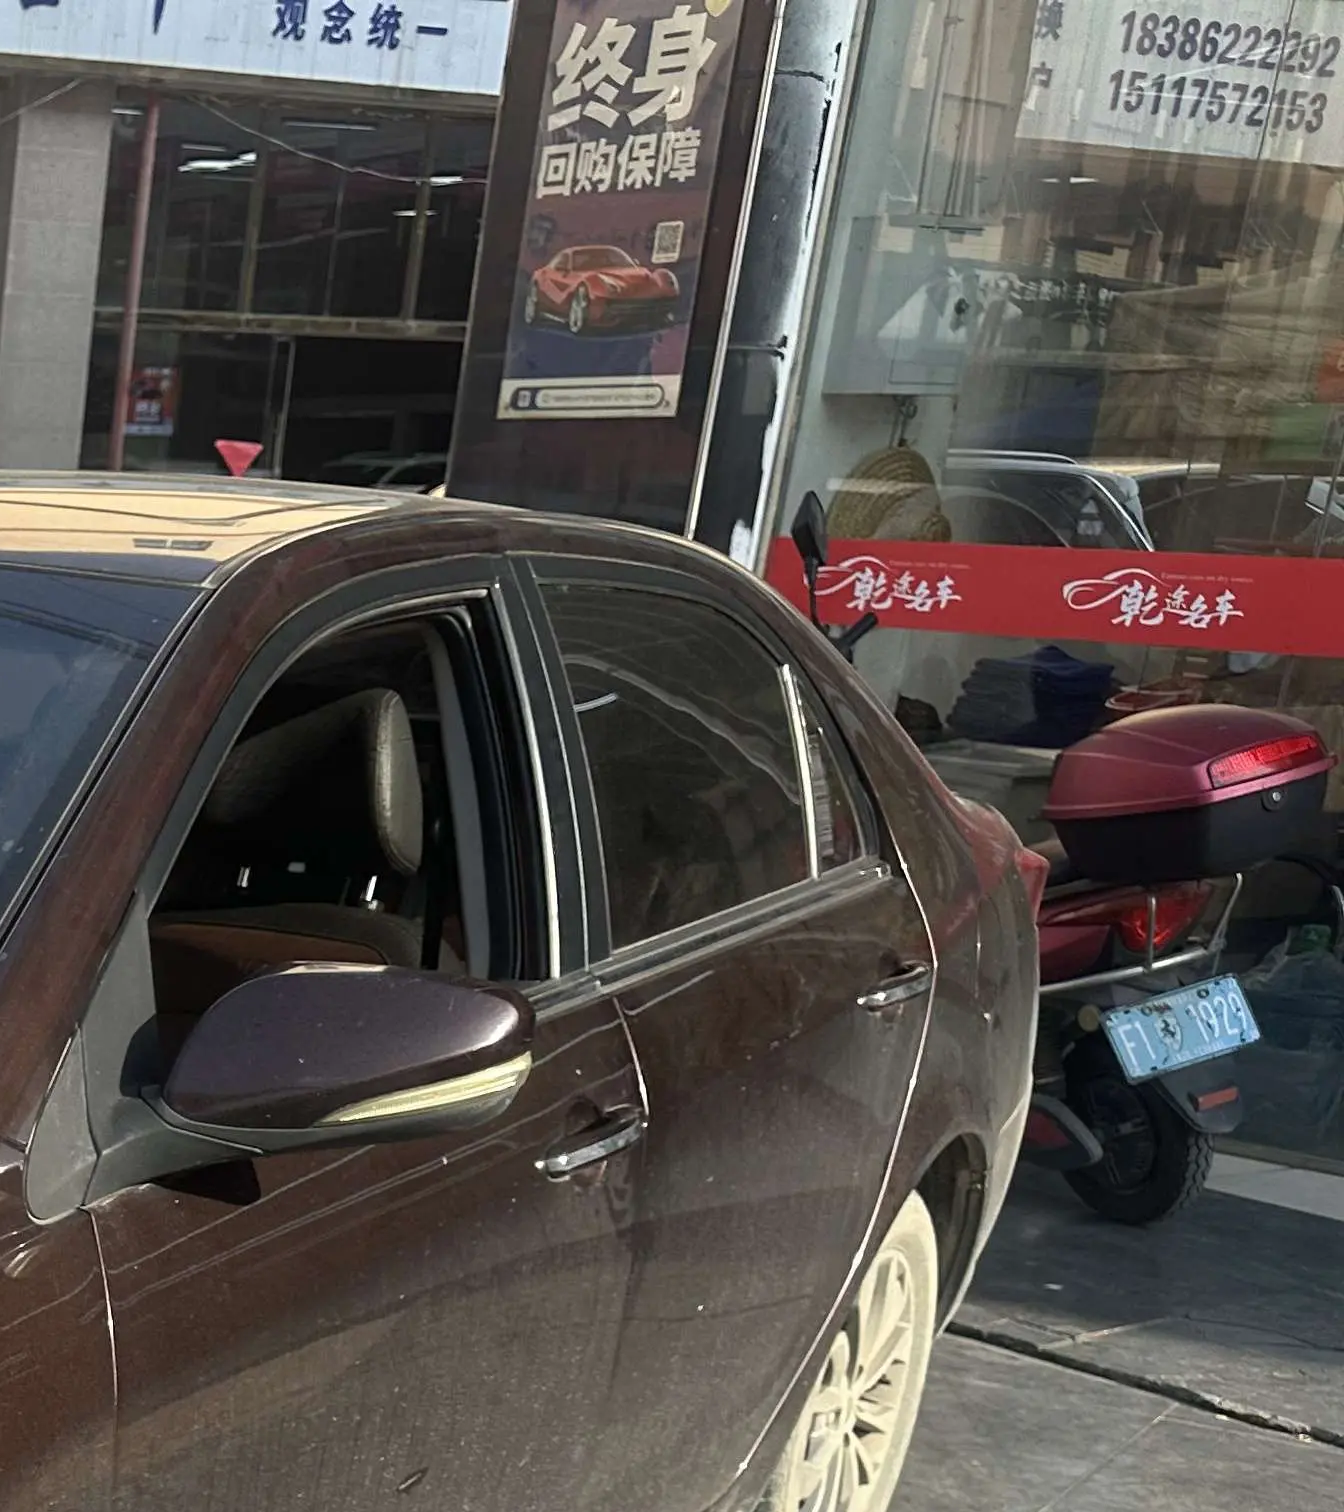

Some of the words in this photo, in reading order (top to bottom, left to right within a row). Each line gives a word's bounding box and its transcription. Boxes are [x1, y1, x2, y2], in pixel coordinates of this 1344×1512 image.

[271, 0, 449, 50] 观念统一
[1121, 10, 1340, 78] 18386222292
[547, 4, 716, 131] 终身
[1109, 69, 1327, 133] 15117572153
[536, 127, 701, 199] 回购保障
[1118, 1021, 1156, 1072] F1
[1186, 993, 1247, 1043] 1929
